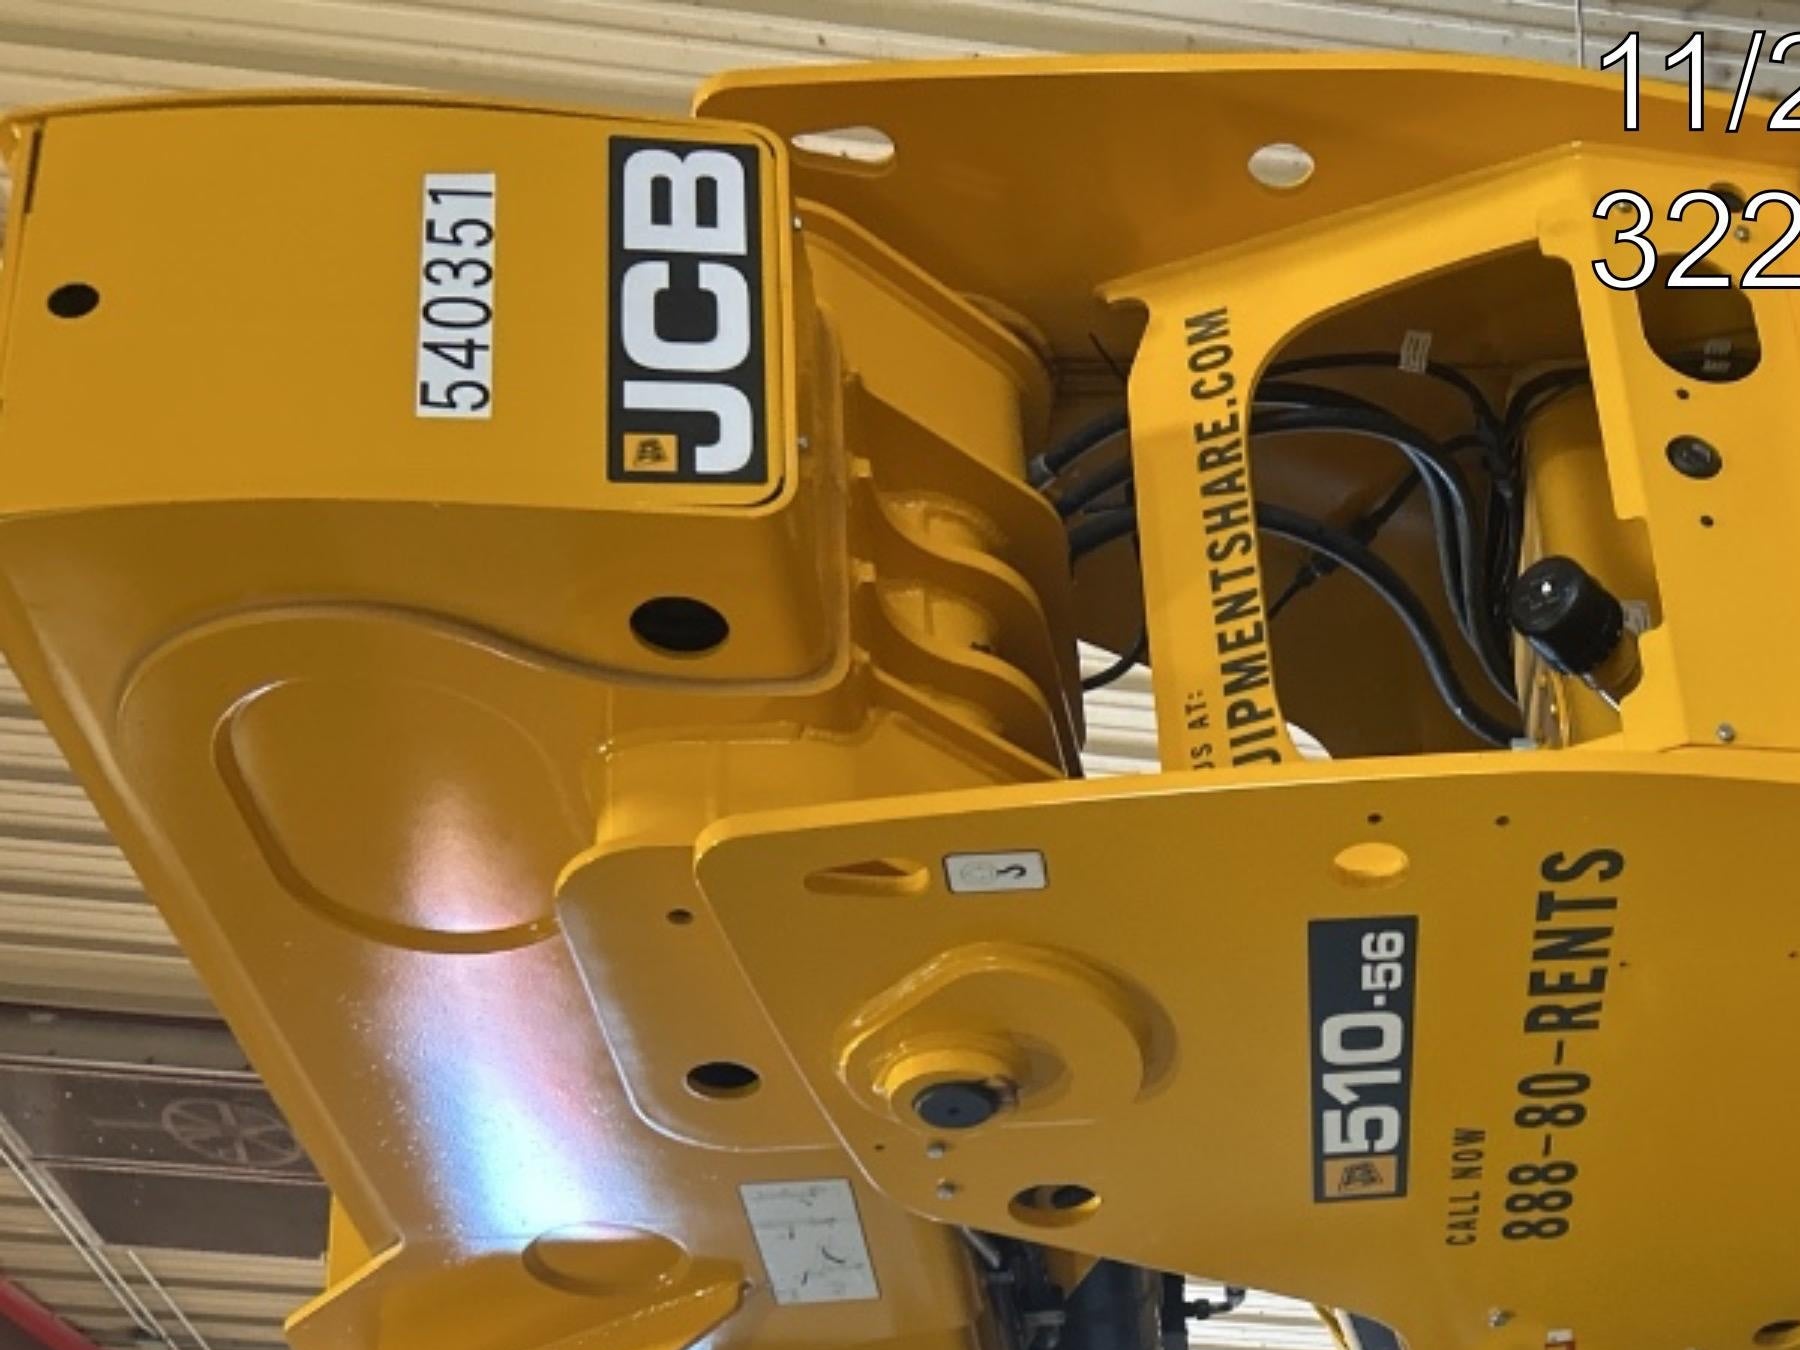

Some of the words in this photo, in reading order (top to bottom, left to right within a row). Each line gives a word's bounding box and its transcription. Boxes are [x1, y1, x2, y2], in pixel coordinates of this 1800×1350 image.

[419, 188, 494, 412] 540351
[620, 148, 755, 475] JCB
[1452, 1128, 1486, 1180] NOW
[1501, 848, 1626, 1240] 888-80-RENTS
[1446, 1190, 1481, 1247] CALL
